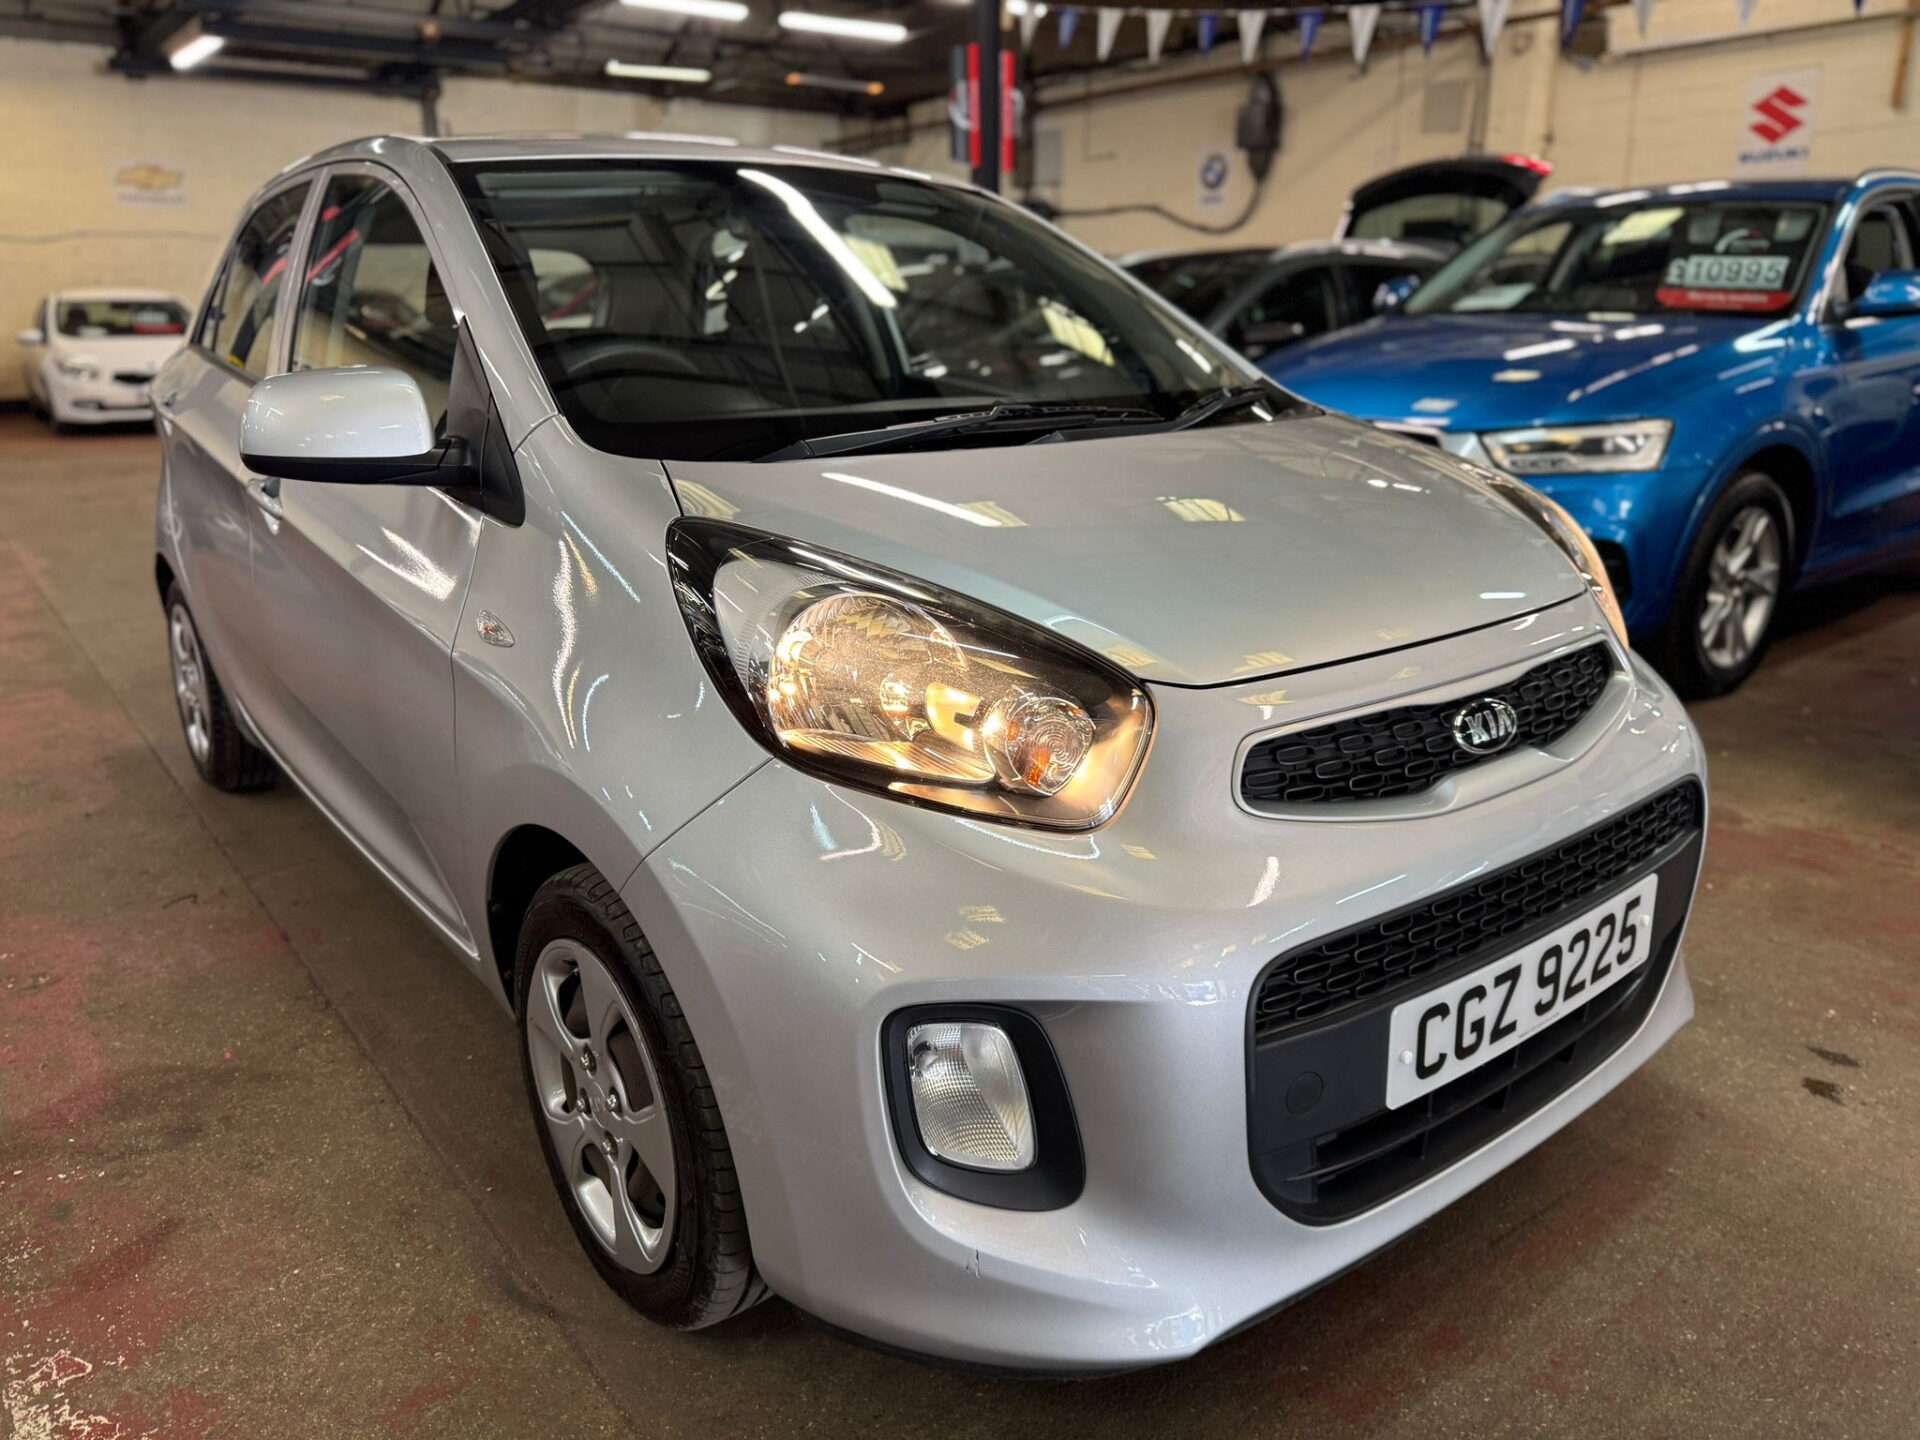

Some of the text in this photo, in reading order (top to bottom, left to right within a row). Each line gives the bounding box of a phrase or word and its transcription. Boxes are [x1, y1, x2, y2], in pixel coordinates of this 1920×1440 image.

[1463, 705, 1513, 746] KIA
[1415, 895, 1642, 1081] CGZ 9225
